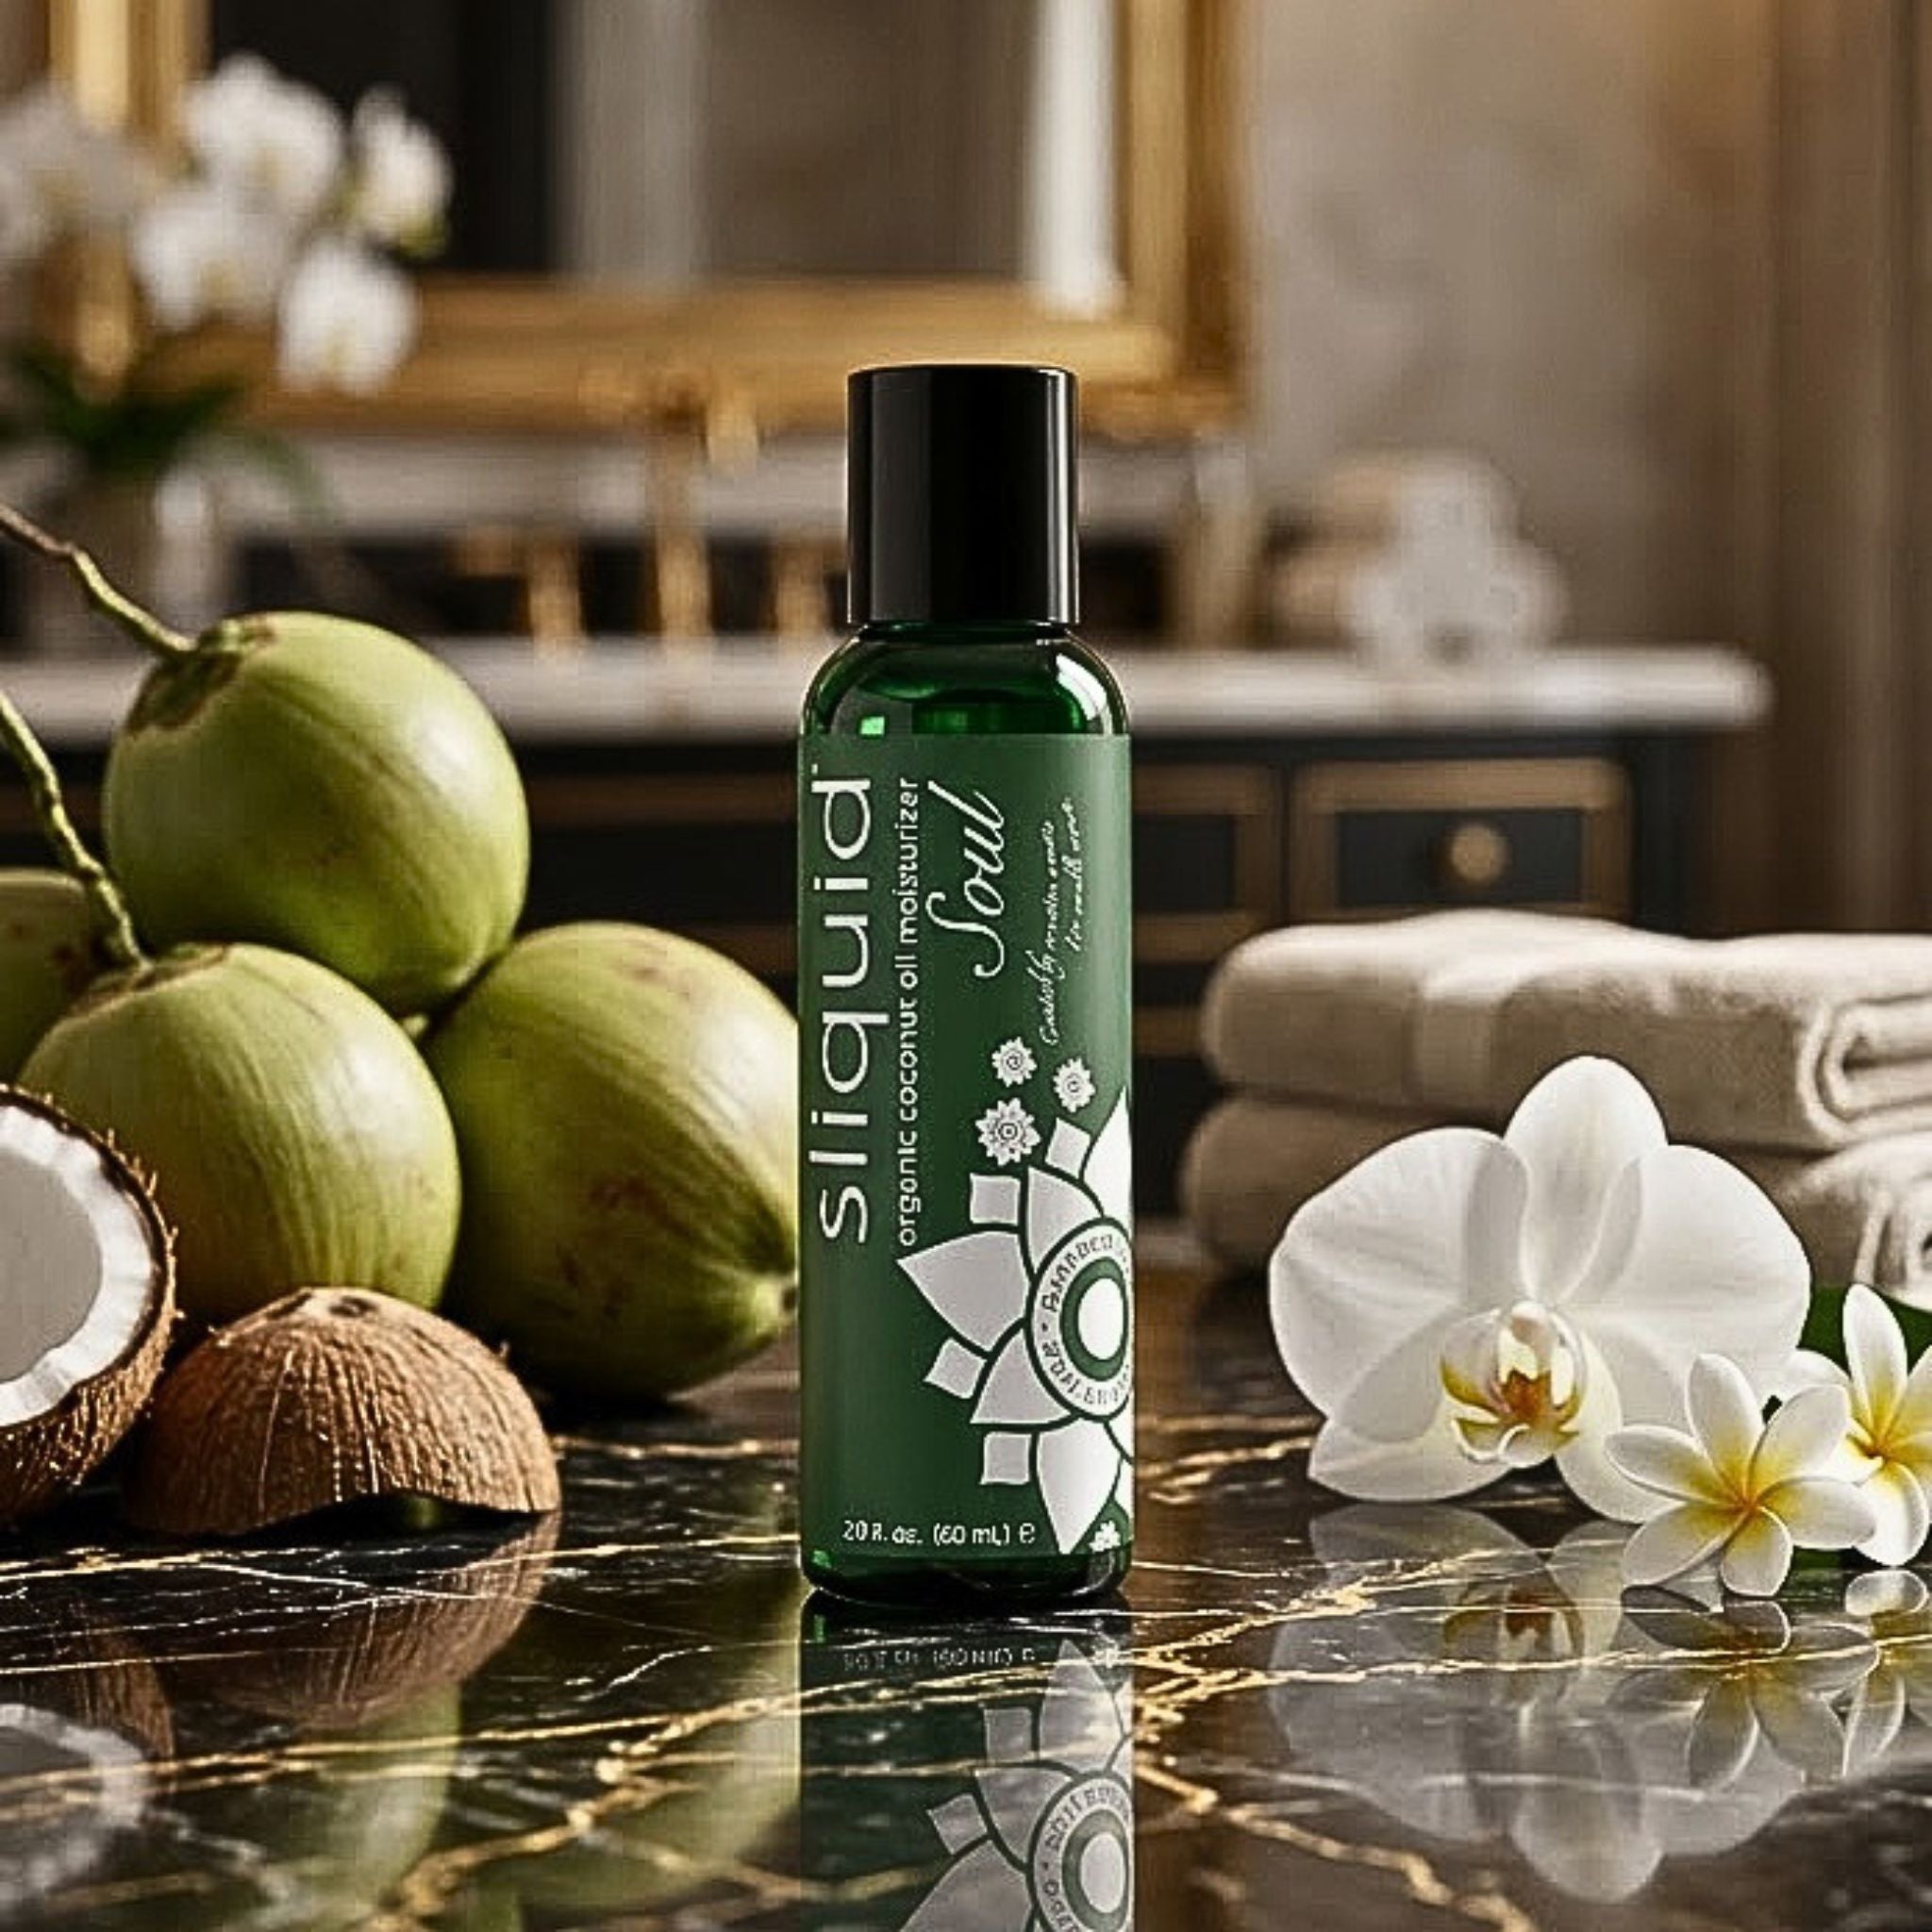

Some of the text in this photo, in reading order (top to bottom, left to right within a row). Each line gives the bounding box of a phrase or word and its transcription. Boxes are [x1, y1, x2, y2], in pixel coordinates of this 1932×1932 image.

[892, 777, 918, 943] moisturizer
[924, 780, 1005, 977] Soul
[808, 778, 890, 1243] sliquid
[897, 997, 918, 1122] coconut
